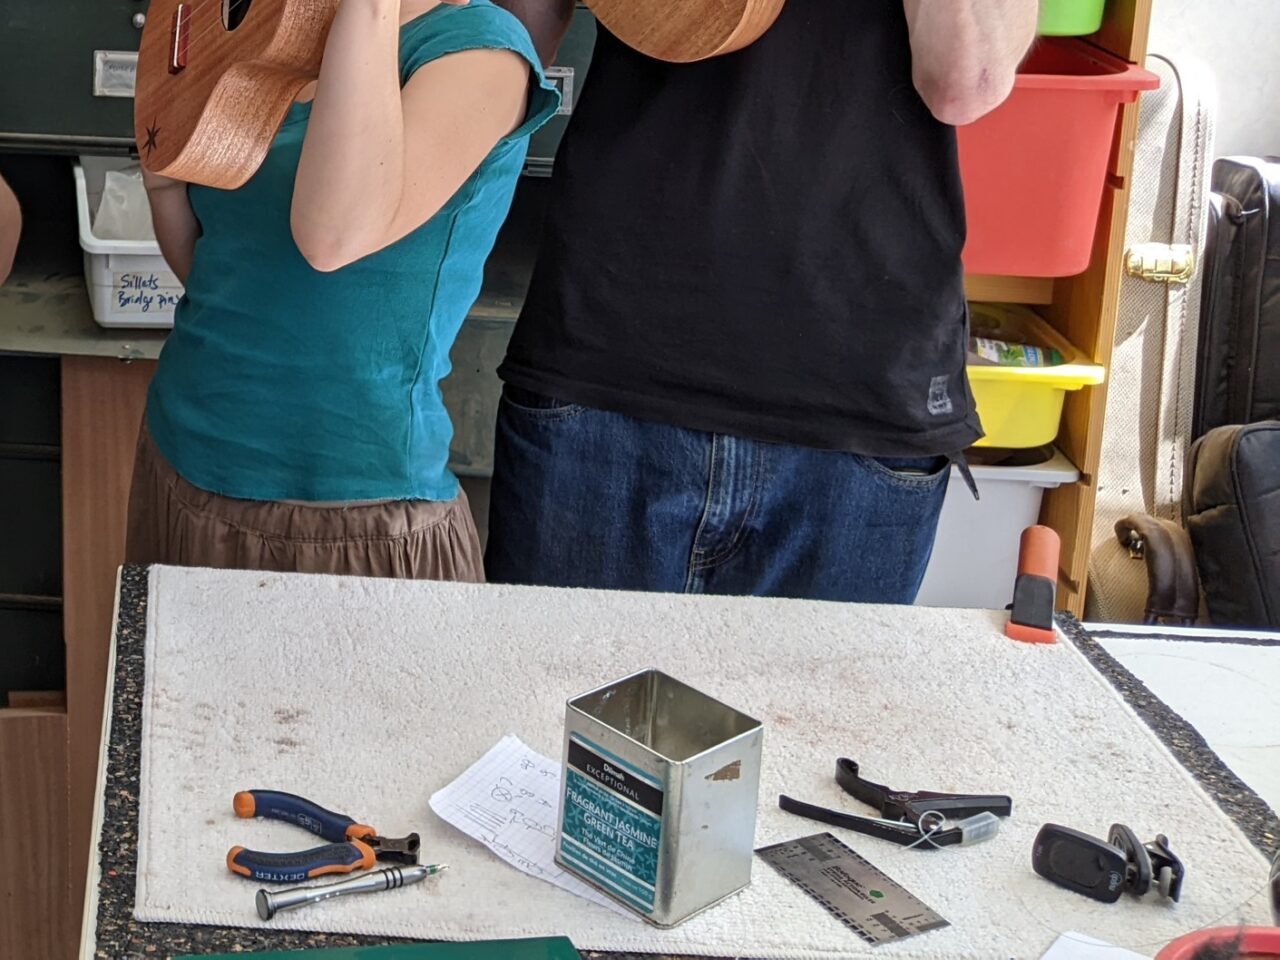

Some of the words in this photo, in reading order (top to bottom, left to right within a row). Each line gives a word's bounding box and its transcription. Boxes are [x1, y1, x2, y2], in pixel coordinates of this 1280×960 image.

[117, 290, 153, 312] Bridge
[586, 763, 640, 801] EXCEPTIONAL
[566, 787, 613, 823] FRAGRANT
[614, 816, 658, 849] JASMINE
[583, 812, 614, 839] GREEN
[616, 830, 635, 851] TEA
[255, 871, 305, 882] DEXTER
